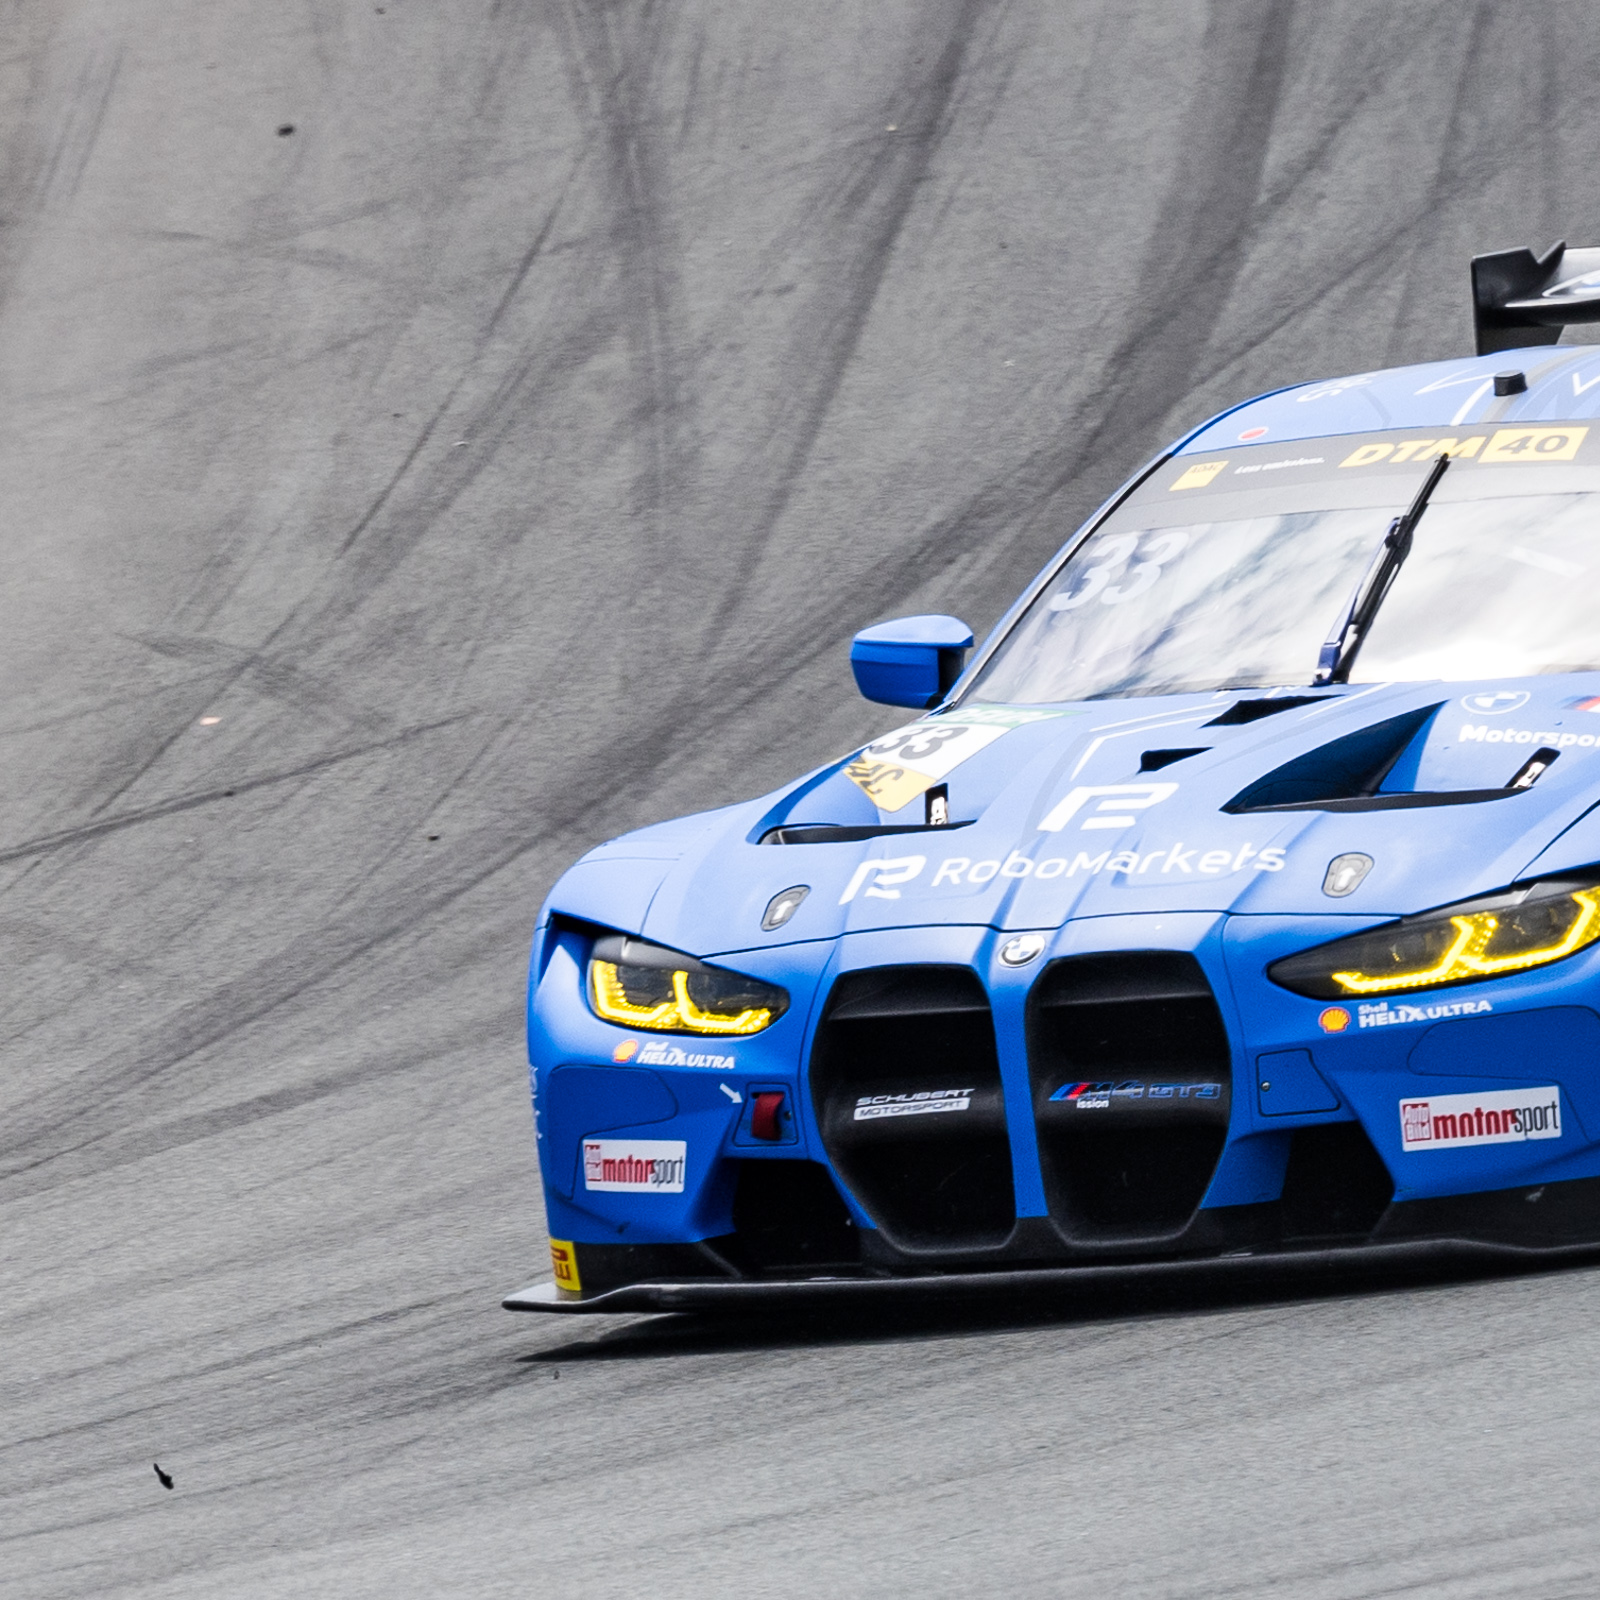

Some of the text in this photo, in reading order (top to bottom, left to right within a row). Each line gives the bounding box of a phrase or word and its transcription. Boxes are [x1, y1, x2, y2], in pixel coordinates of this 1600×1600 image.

[1338, 435, 1488, 469] DTM
[1498, 434, 1570, 455] 40
[1049, 531, 1190, 612] 33
[870, 725, 970, 761] 33
[930, 842, 1289, 888] RoboMarkets
[1358, 1002, 1389, 1016] Shell
[1358, 999, 1493, 1029] HELIX ULTRA
[635, 1046, 736, 1070] HELIX ULTRA
[855, 1087, 976, 1106] SCHUBERT
[1147, 1082, 1223, 1100] GT3
[858, 1099, 970, 1118] MOTORSPORT
[1432, 1100, 1560, 1141] motorsport
[601, 1154, 685, 1188] motorsport
